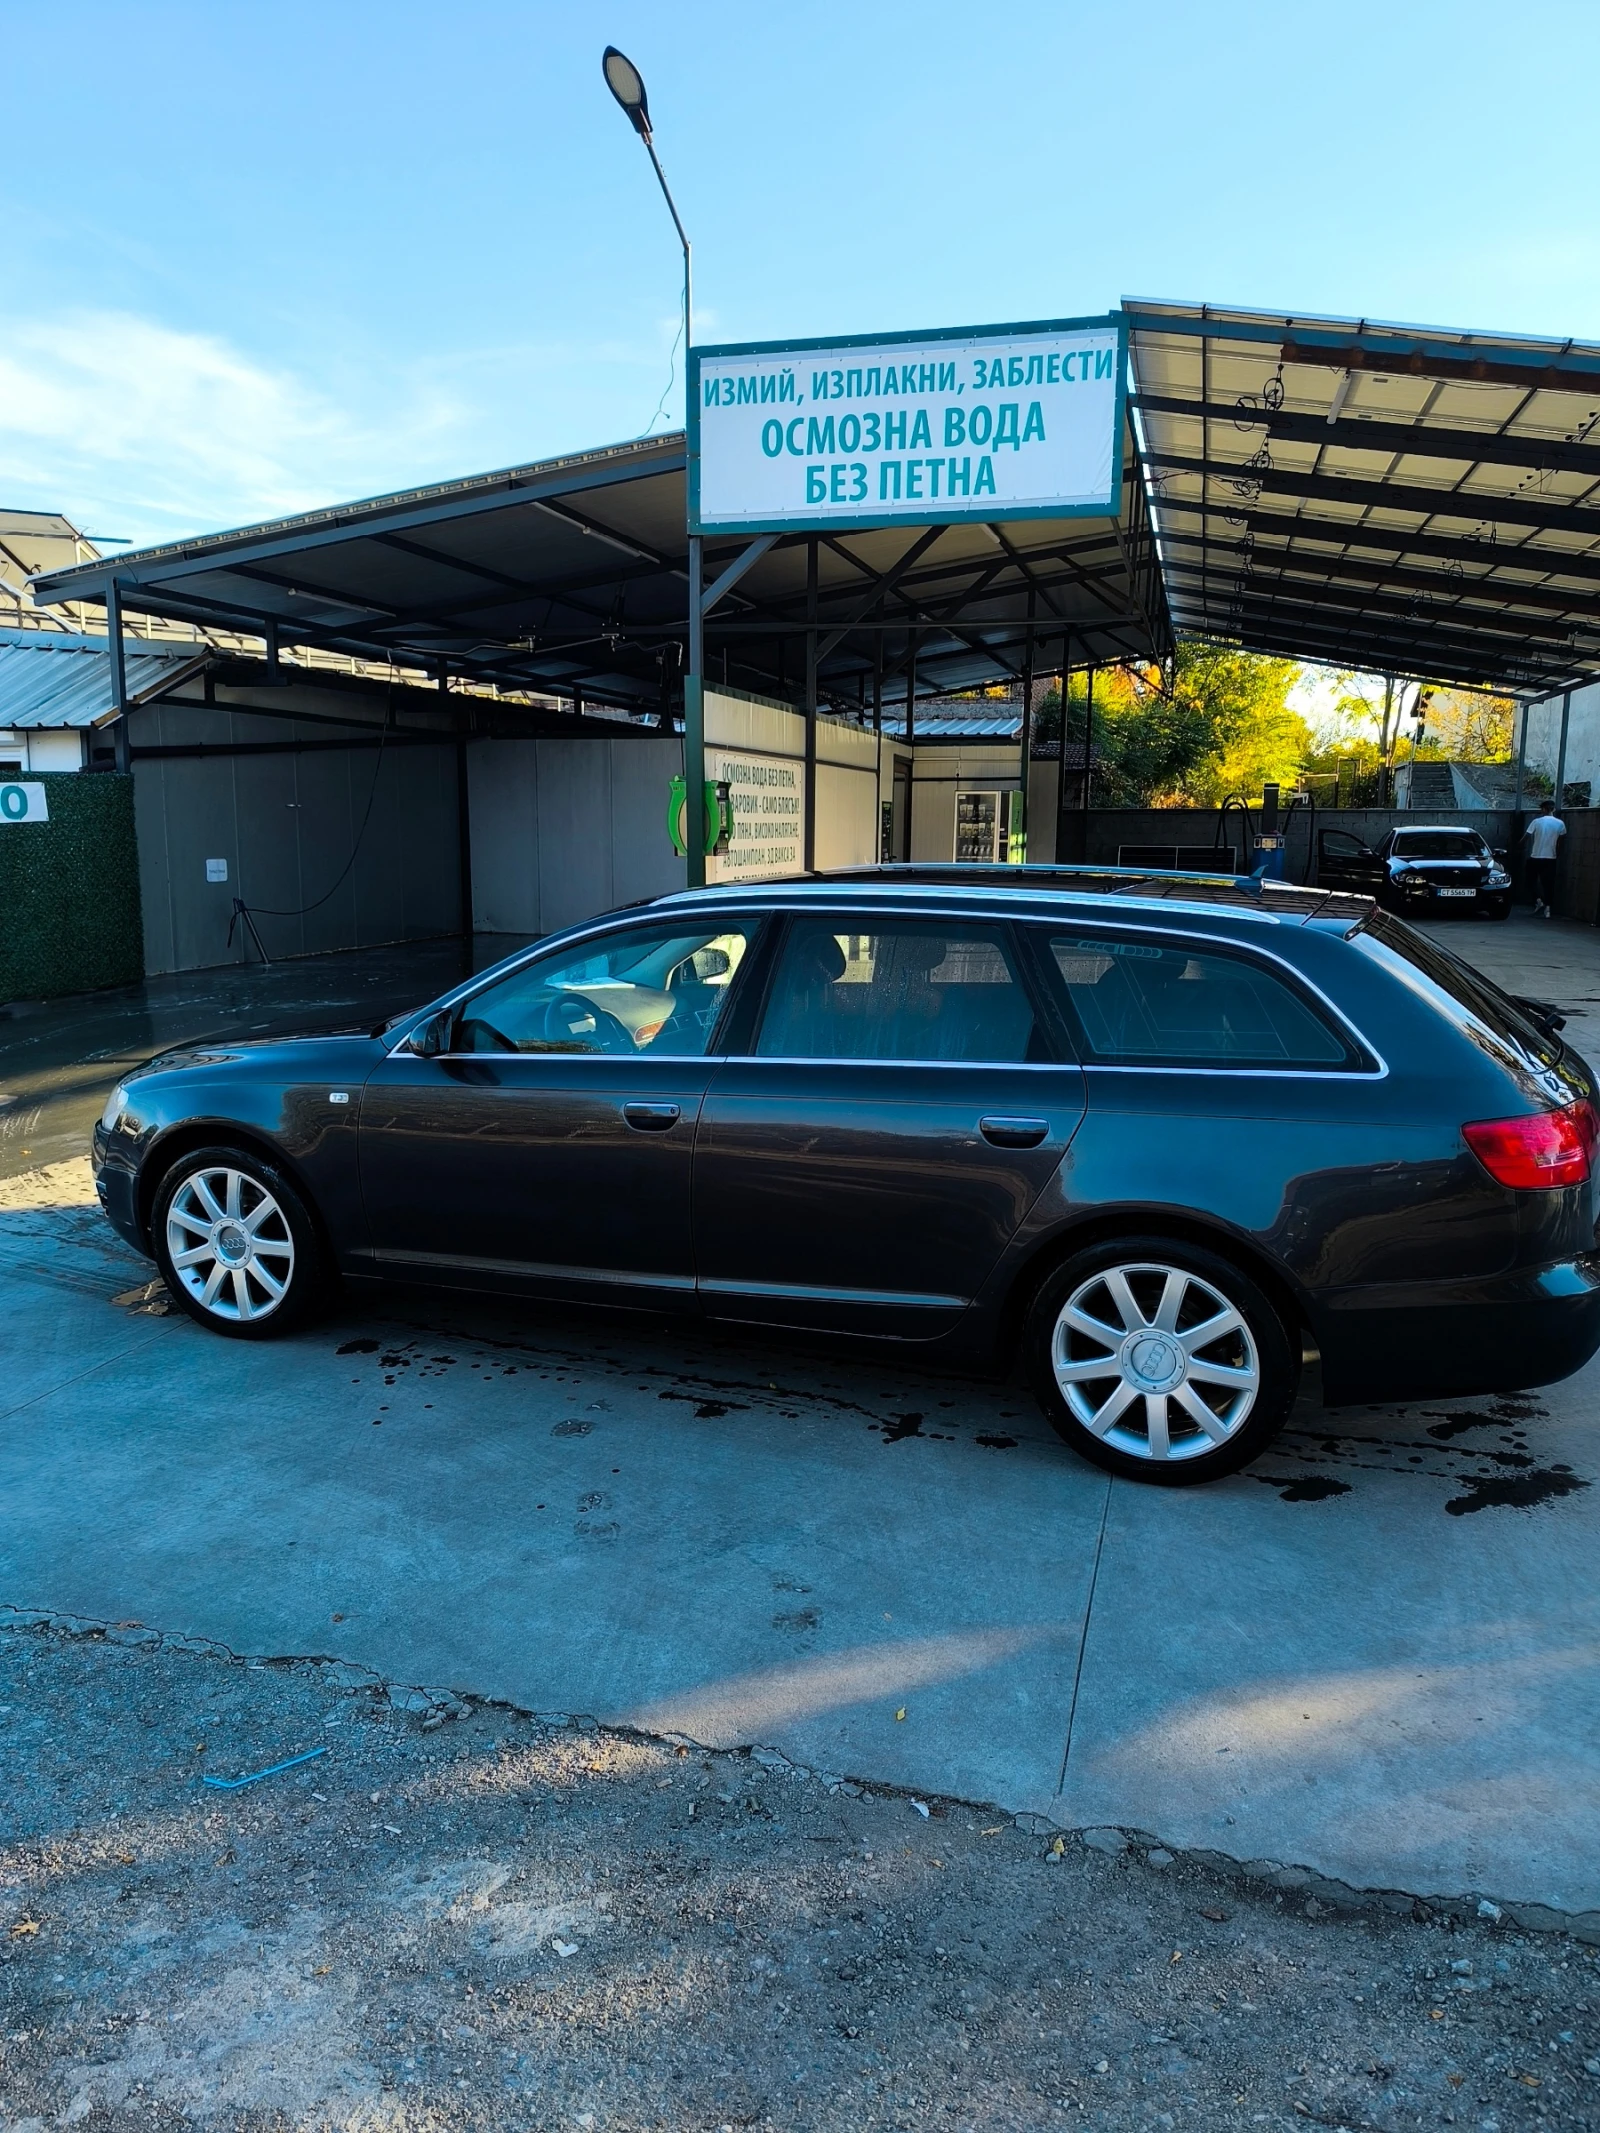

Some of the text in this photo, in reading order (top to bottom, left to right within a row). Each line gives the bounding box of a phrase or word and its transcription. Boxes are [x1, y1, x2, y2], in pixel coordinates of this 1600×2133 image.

[704, 349, 1113, 407] ИЗМИЙ, ИЗПЛАКНИ, ЗАБЛЕСТИ
[761, 401, 1046, 458] ОСМОЗНА ВОДА
[806, 455, 997, 504] БЕЗ ПЕТНА
[723, 762, 751, 785] ОСМОЗНА
[752, 766, 767, 789] ВОДА
[768, 768, 778, 787] БЕЗ
[762, 795, 777, 814] САМО
[755, 822, 774, 839] ВИСОКО
